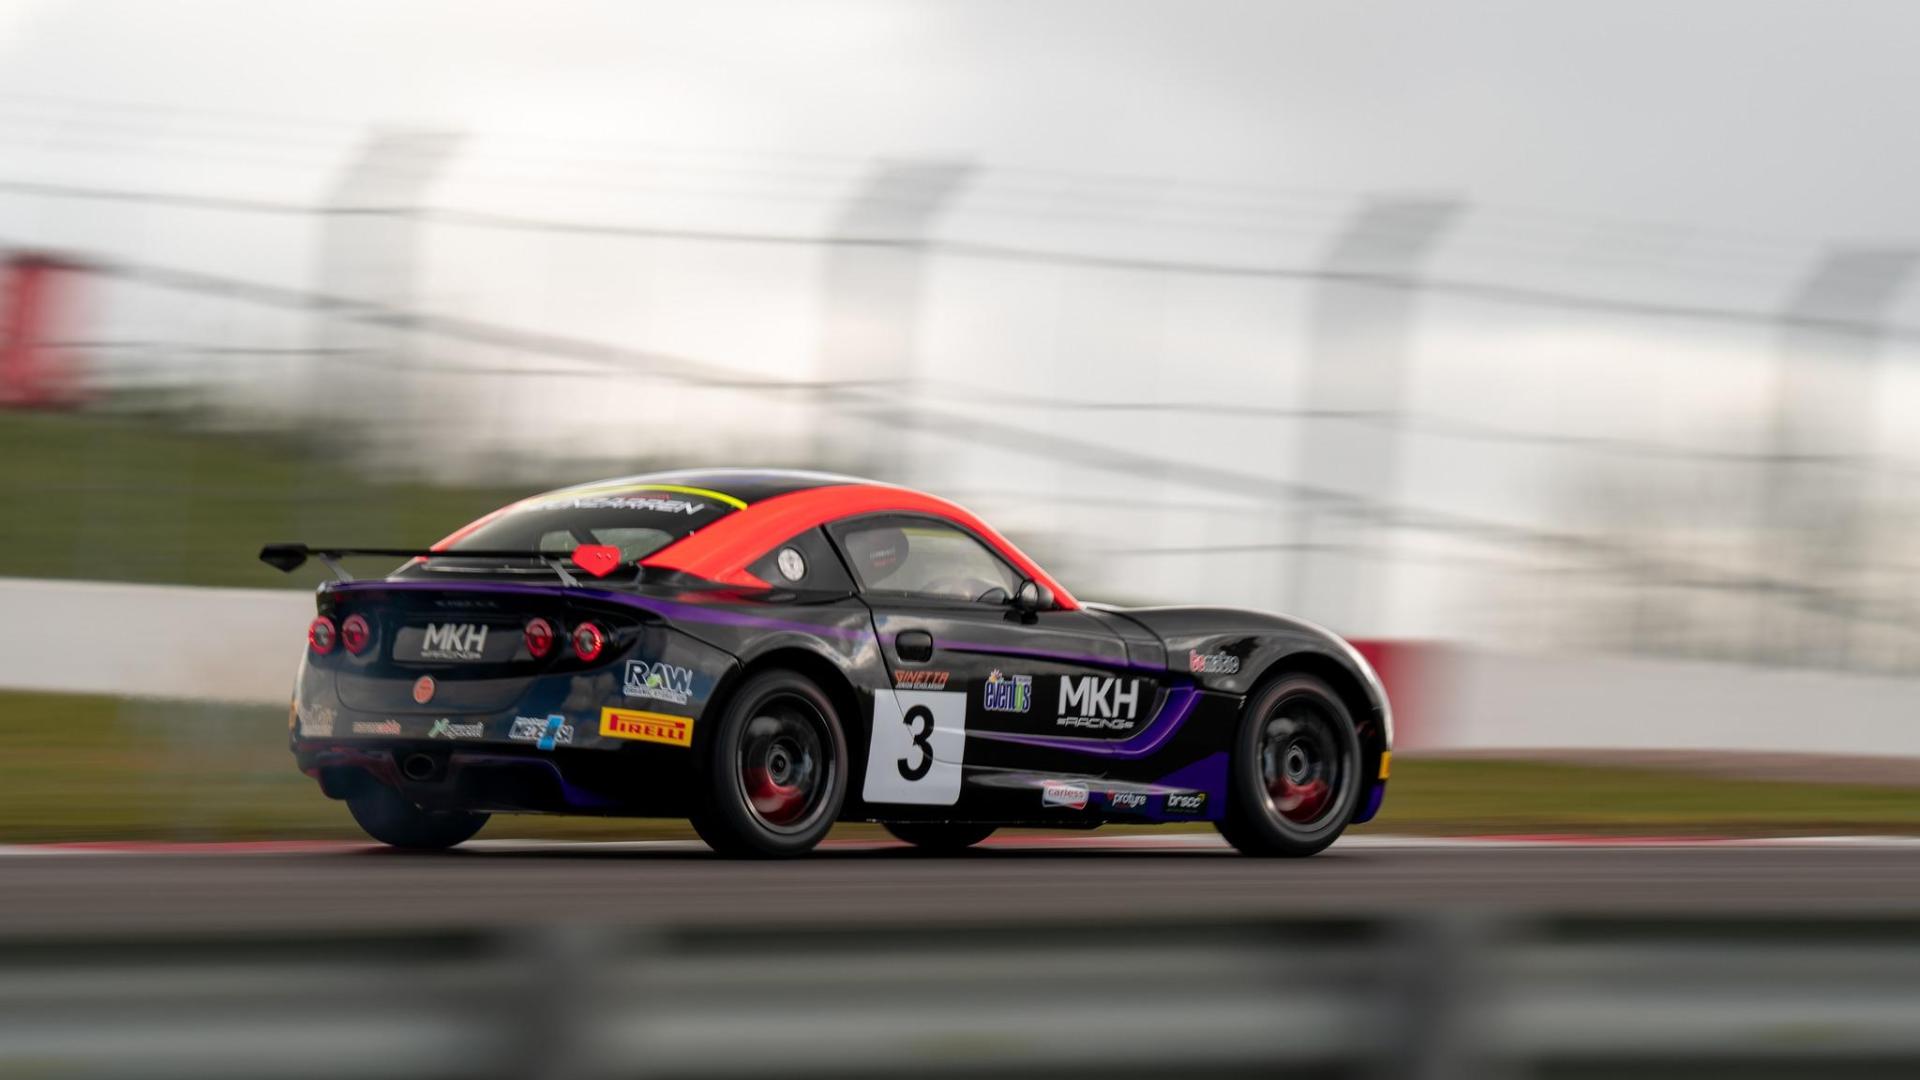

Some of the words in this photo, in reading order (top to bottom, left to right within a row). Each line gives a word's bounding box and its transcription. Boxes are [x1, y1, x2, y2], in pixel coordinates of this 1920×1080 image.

[422, 623, 489, 652] MKH
[623, 659, 694, 695] RAW
[984, 676, 1032, 713] eventos
[1058, 675, 1140, 719] MKH
[609, 713, 687, 741] PIRELLI
[897, 704, 935, 782] 3
